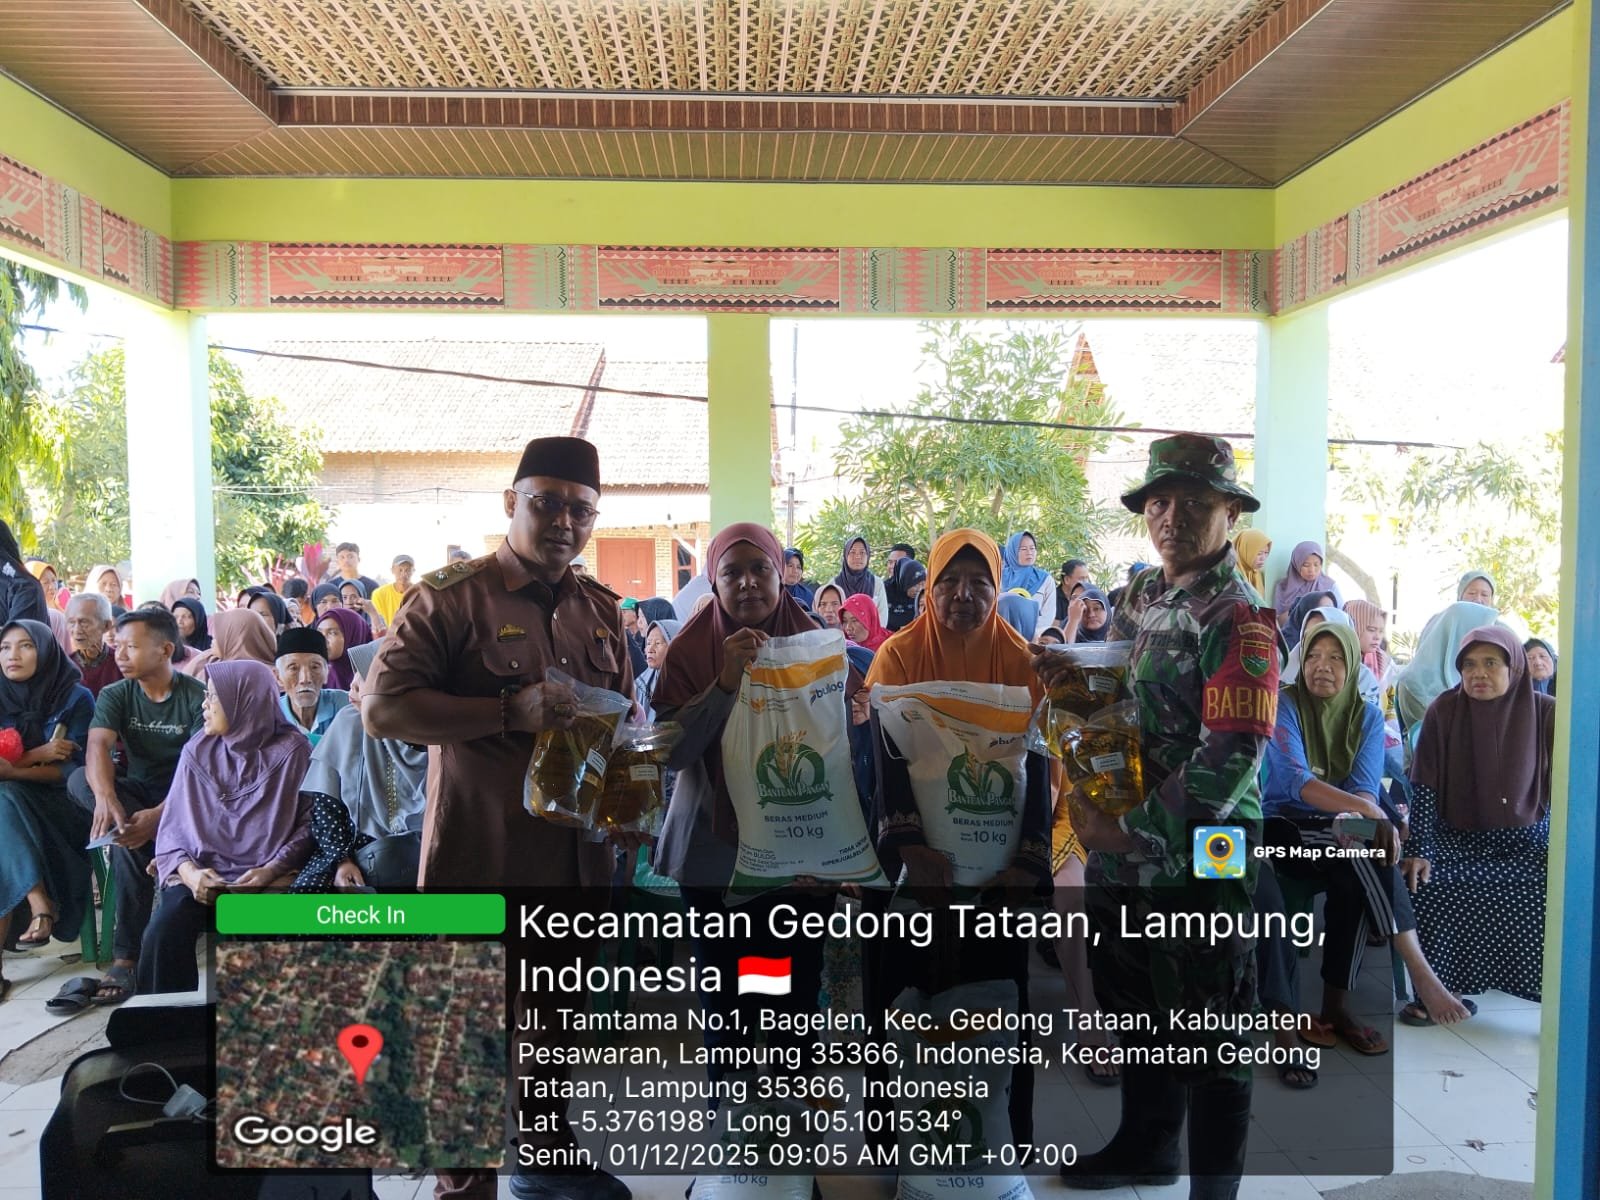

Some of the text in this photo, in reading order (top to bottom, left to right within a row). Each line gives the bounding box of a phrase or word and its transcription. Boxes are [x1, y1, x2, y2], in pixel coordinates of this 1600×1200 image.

[816, 681, 844, 698] bulog
[764, 811, 829, 823] BERAS MEDIUM
[953, 817, 1014, 827] BERAS MEDIUM
[787, 825, 804, 839] 10
[807, 825, 824, 839] kg
[973, 831, 989, 843] 10
[992, 831, 1007, 845] kg
[734, 1173, 749, 1184] 10
[751, 1173, 768, 1187] kg
[949, 1177, 965, 1188] 10
[968, 1176, 984, 1188] kg
